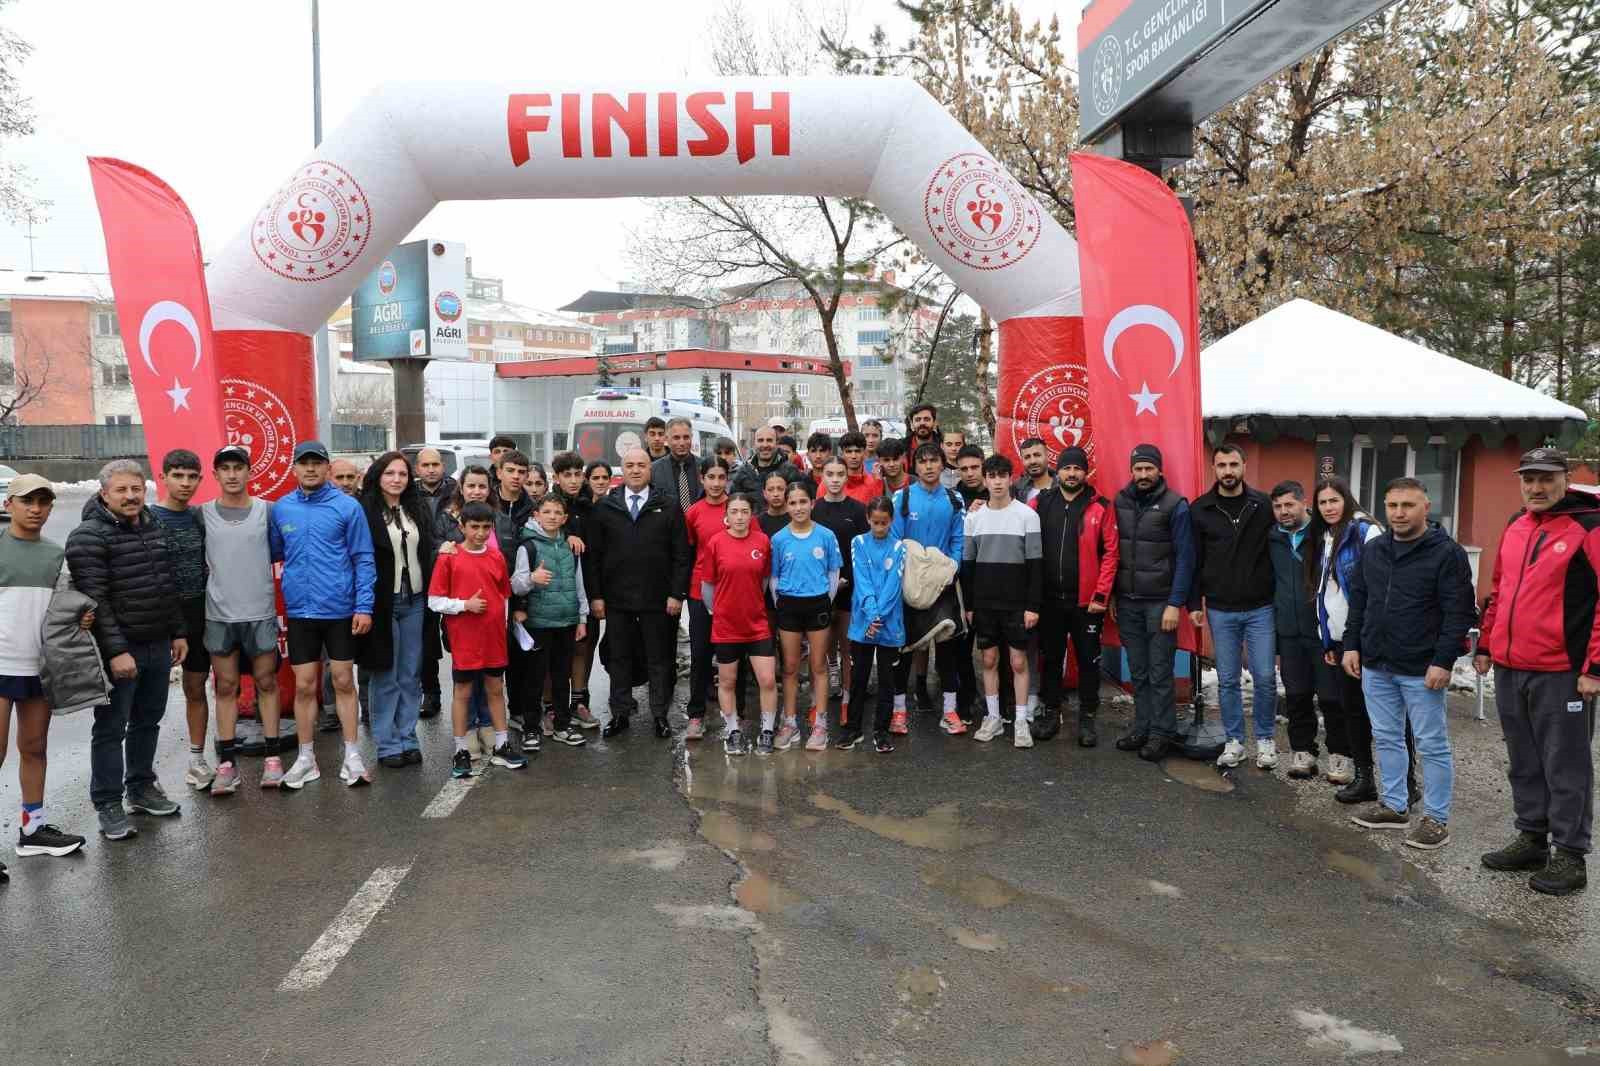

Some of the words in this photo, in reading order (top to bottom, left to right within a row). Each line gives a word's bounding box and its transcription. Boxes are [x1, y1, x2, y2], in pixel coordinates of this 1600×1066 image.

[1125, 30, 1142, 56] T.C.
[1126, 48, 1150, 80] SPOR
[1151, 0, 1207, 61] BAKANLIĞI
[507, 91, 790, 167] FINISH
[374, 301, 402, 323] AĞRI
[436, 326, 462, 339] AĞRI
[255, 411, 265, 421] VE
[263, 420, 275, 441] SPOR
[584, 410, 635, 418] AMBULANS
